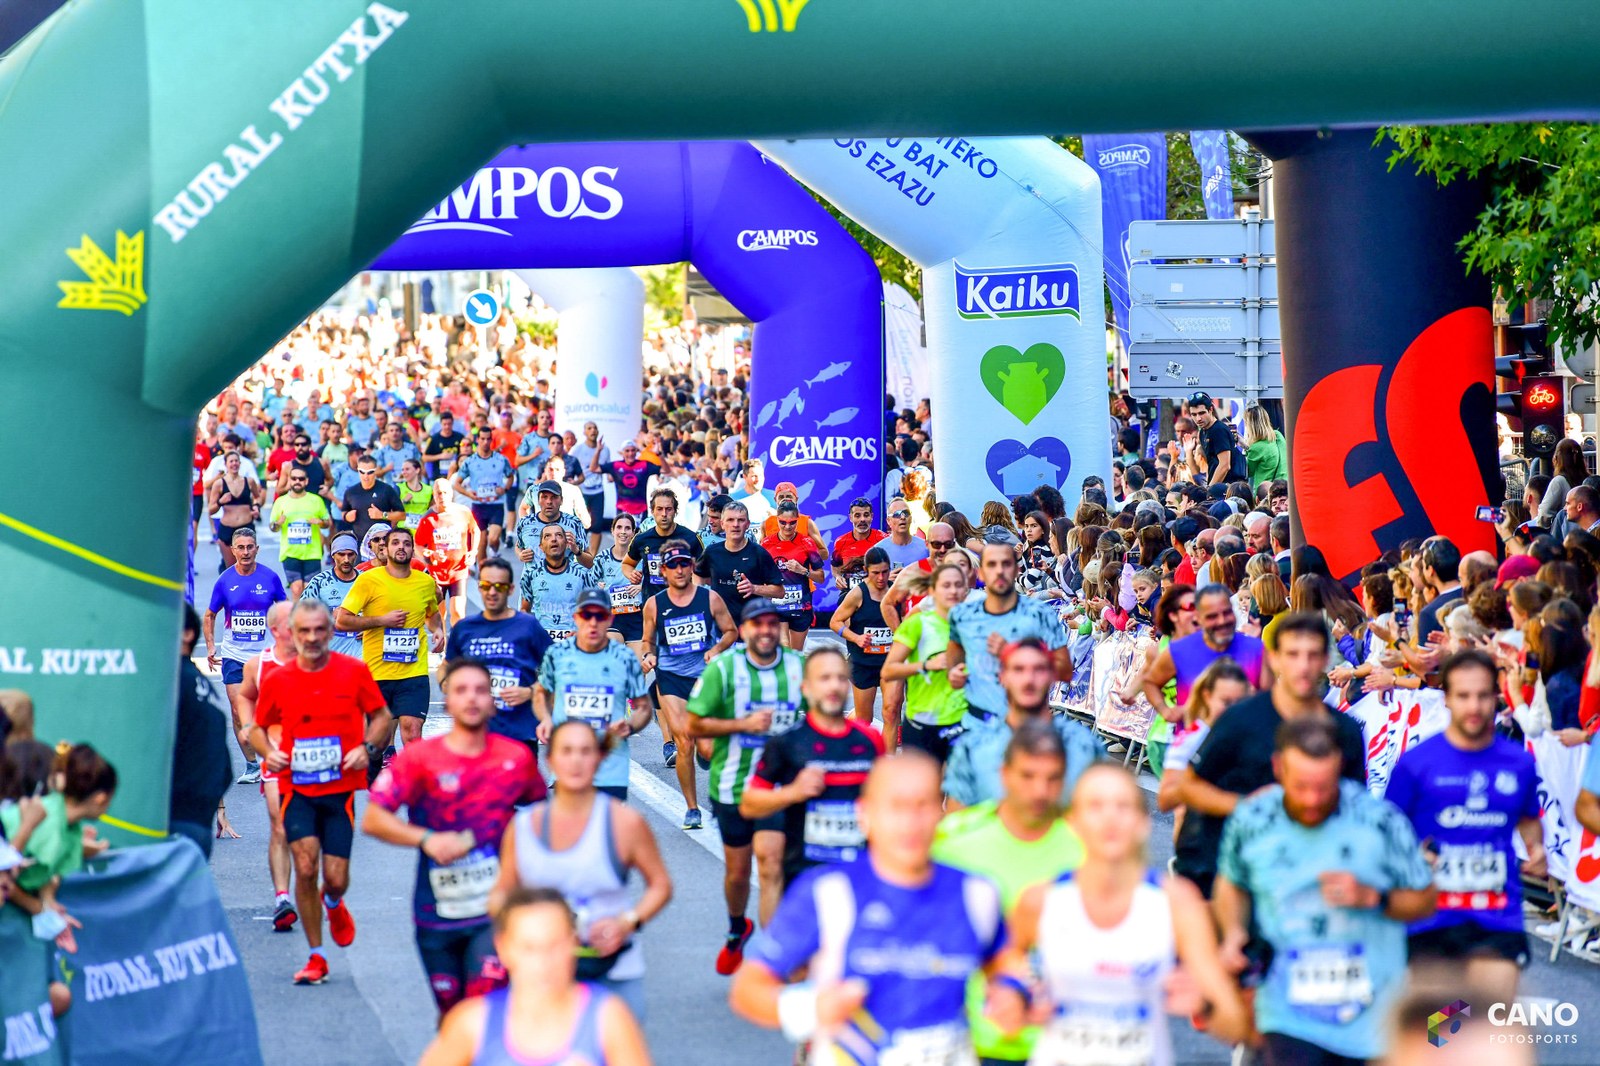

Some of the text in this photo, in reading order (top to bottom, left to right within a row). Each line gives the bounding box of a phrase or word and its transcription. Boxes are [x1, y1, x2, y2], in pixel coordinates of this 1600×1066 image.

[152, 1, 410, 244] RURAL KUTXA
[903, 141, 949, 179] BAT
[865, 151, 936, 206] EZAZU
[424, 166, 624, 221] MPOS
[736, 229, 819, 251] CAMPOS
[966, 274, 1070, 320] Kaiku
[769, 435, 878, 466] CAMPOS
[784, 592, 800, 600] 341
[233, 618, 264, 627] 10686
[668, 622, 704, 638] 9223
[386, 637, 417, 647] 11227
[40, 648, 138, 675] KUTXA
[568, 695, 609, 708] 6721
[294, 749, 337, 762] 11859
[83, 931, 238, 1002] RURAL KUTXA
